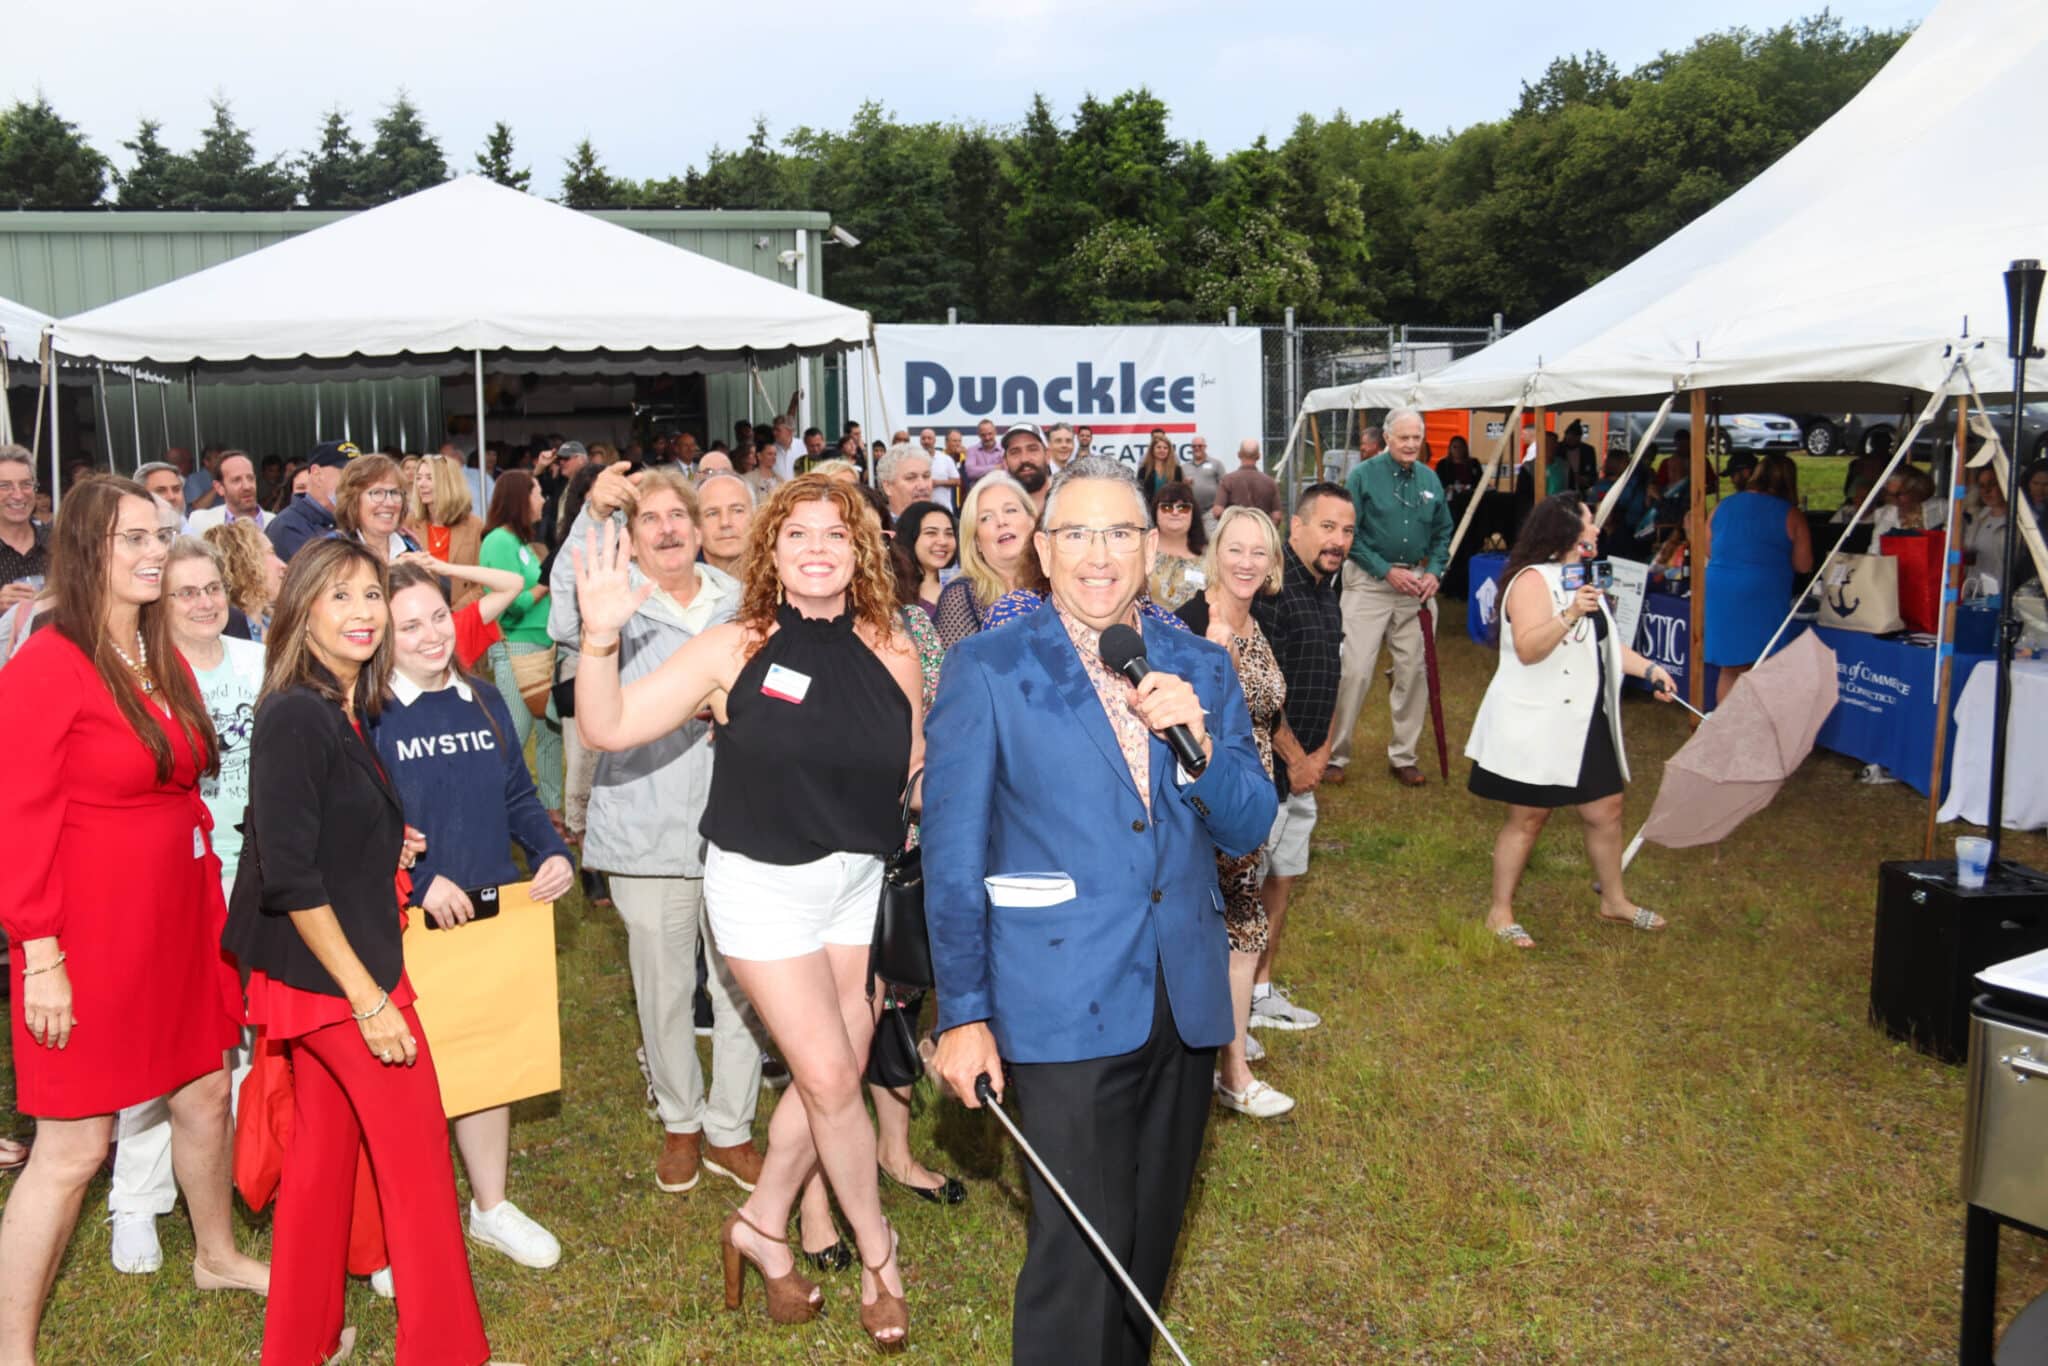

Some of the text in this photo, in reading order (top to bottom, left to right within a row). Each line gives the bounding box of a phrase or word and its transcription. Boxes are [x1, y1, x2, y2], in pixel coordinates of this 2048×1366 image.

[905, 361, 1195, 415] Duncklee
[1092, 443, 1194, 464] EATG
[1642, 612, 1686, 665] STIC
[396, 730, 495, 761] MYSTIC
